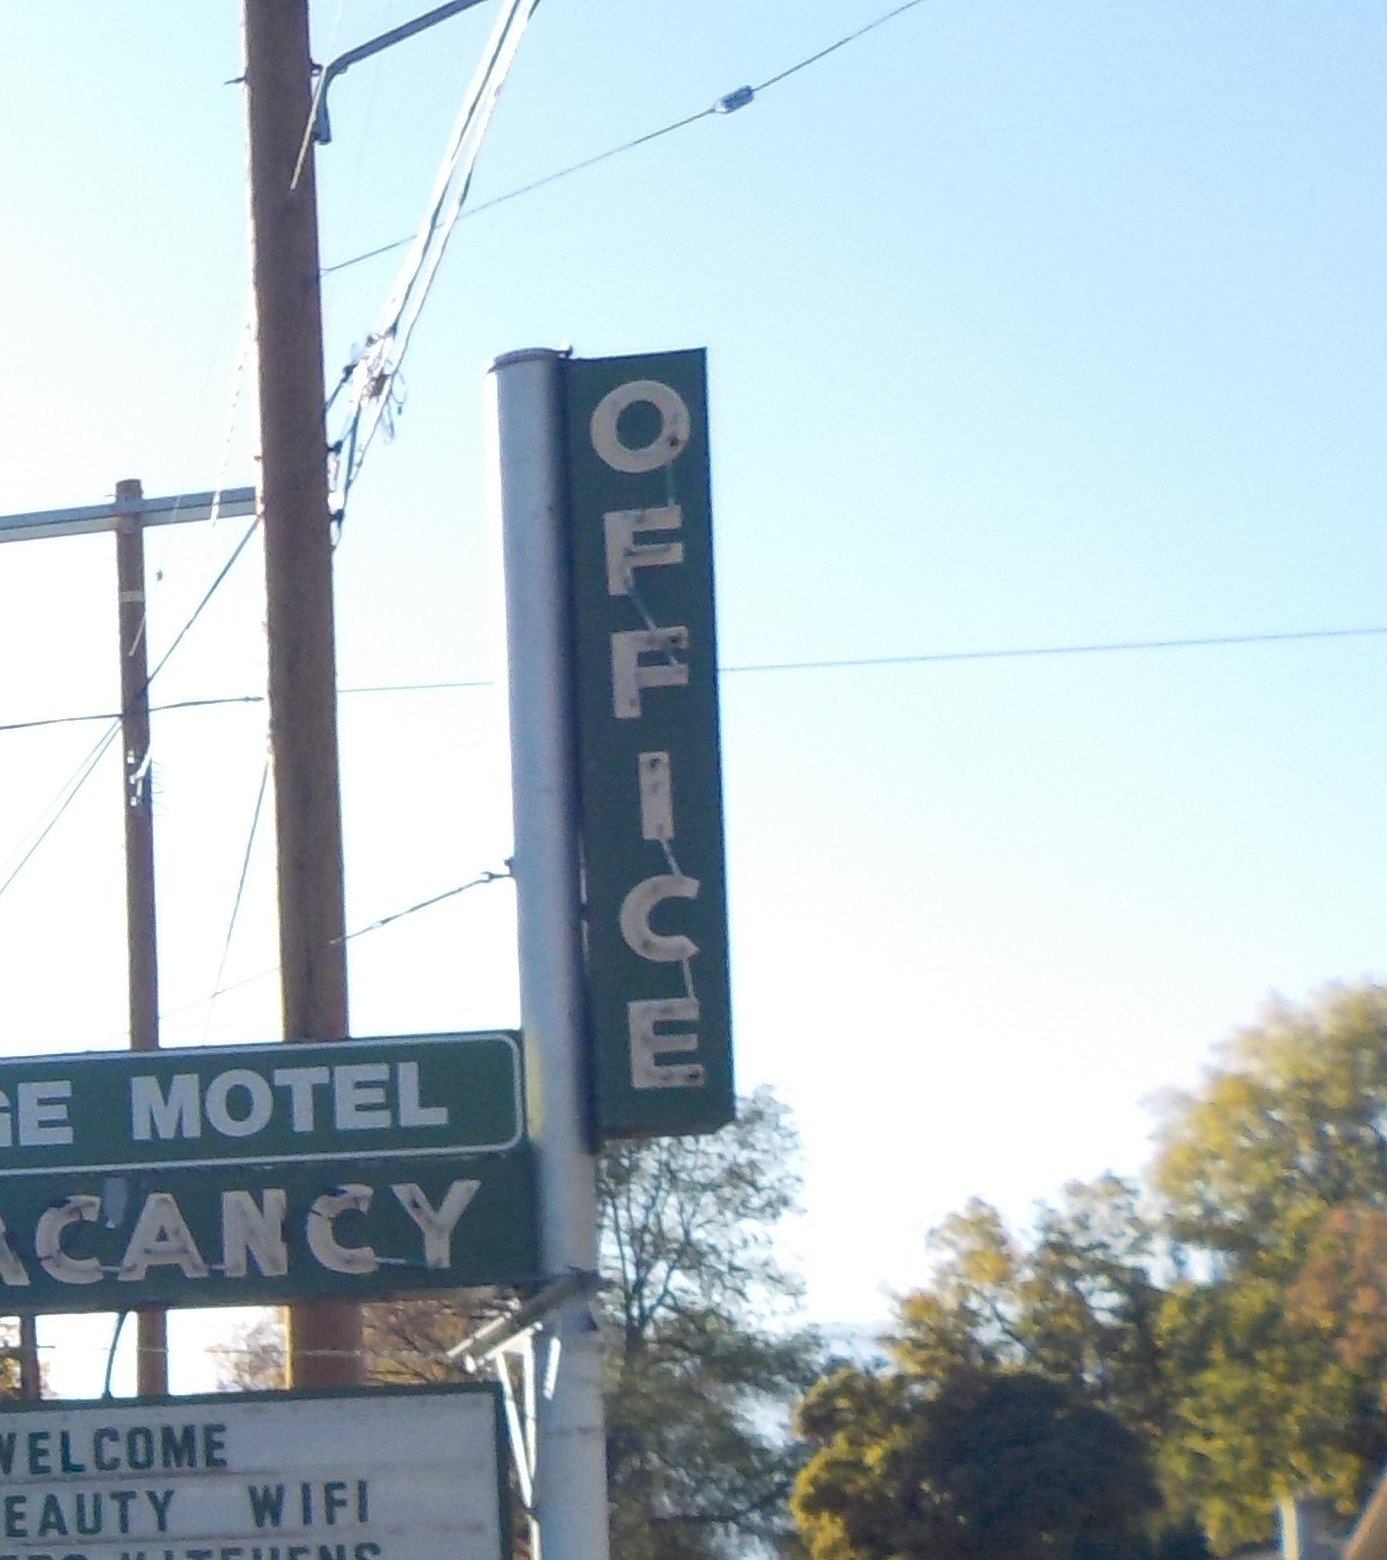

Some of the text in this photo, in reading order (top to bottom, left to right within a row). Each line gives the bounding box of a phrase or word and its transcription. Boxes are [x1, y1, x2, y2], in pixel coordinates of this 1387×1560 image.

[590, 380, 704, 1090] OFFICE
[130, 1061, 449, 1142] MOTEL
[249, 1480, 372, 1528] WIFI
